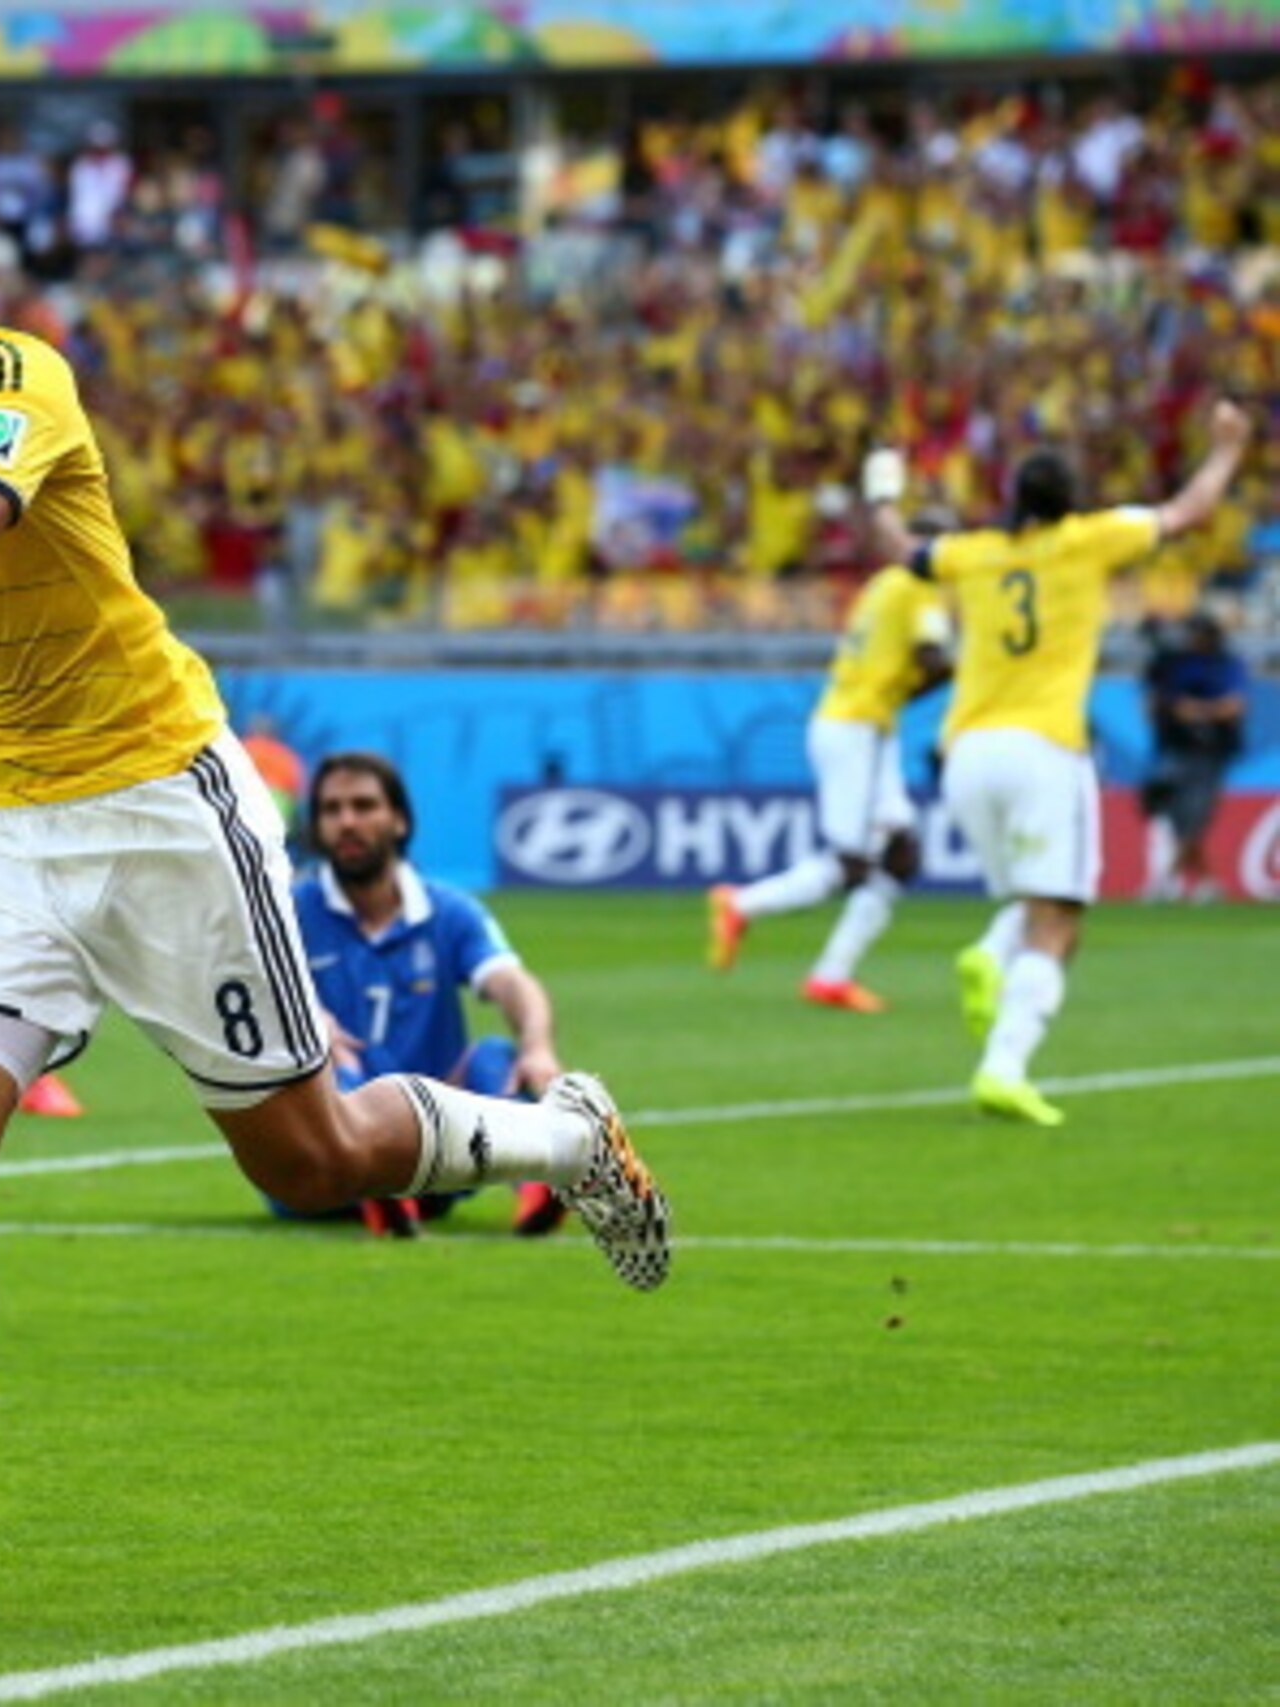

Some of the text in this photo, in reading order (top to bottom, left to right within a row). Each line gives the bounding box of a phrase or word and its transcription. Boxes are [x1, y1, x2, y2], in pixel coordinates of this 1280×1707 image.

[1000, 569, 1039, 657] 3
[215, 980, 263, 1058] 8
[364, 984, 392, 1045] 7
